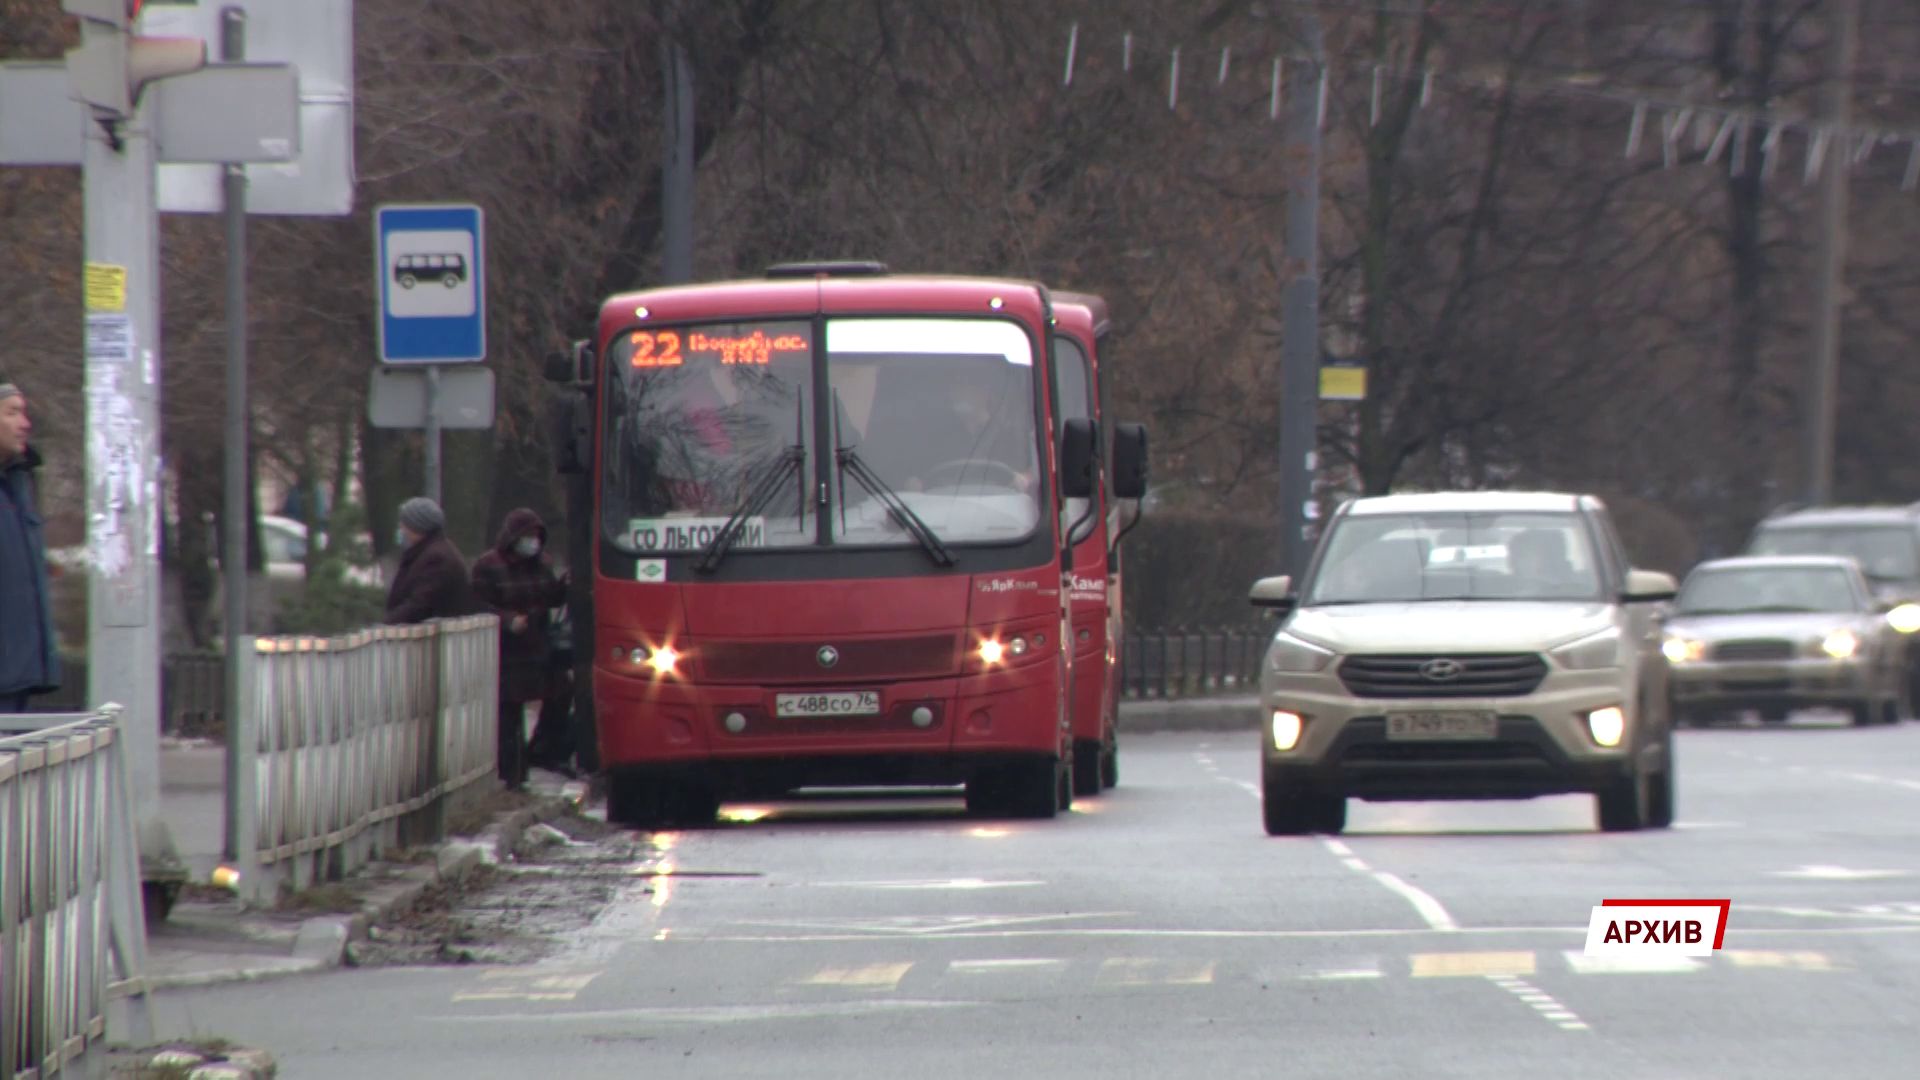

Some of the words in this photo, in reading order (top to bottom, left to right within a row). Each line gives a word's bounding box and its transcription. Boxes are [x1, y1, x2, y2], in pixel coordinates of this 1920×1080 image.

[630, 330, 683, 366] 22
[633, 527, 658, 550] СО
[664, 525, 763, 550] ЛЬГОТМИ
